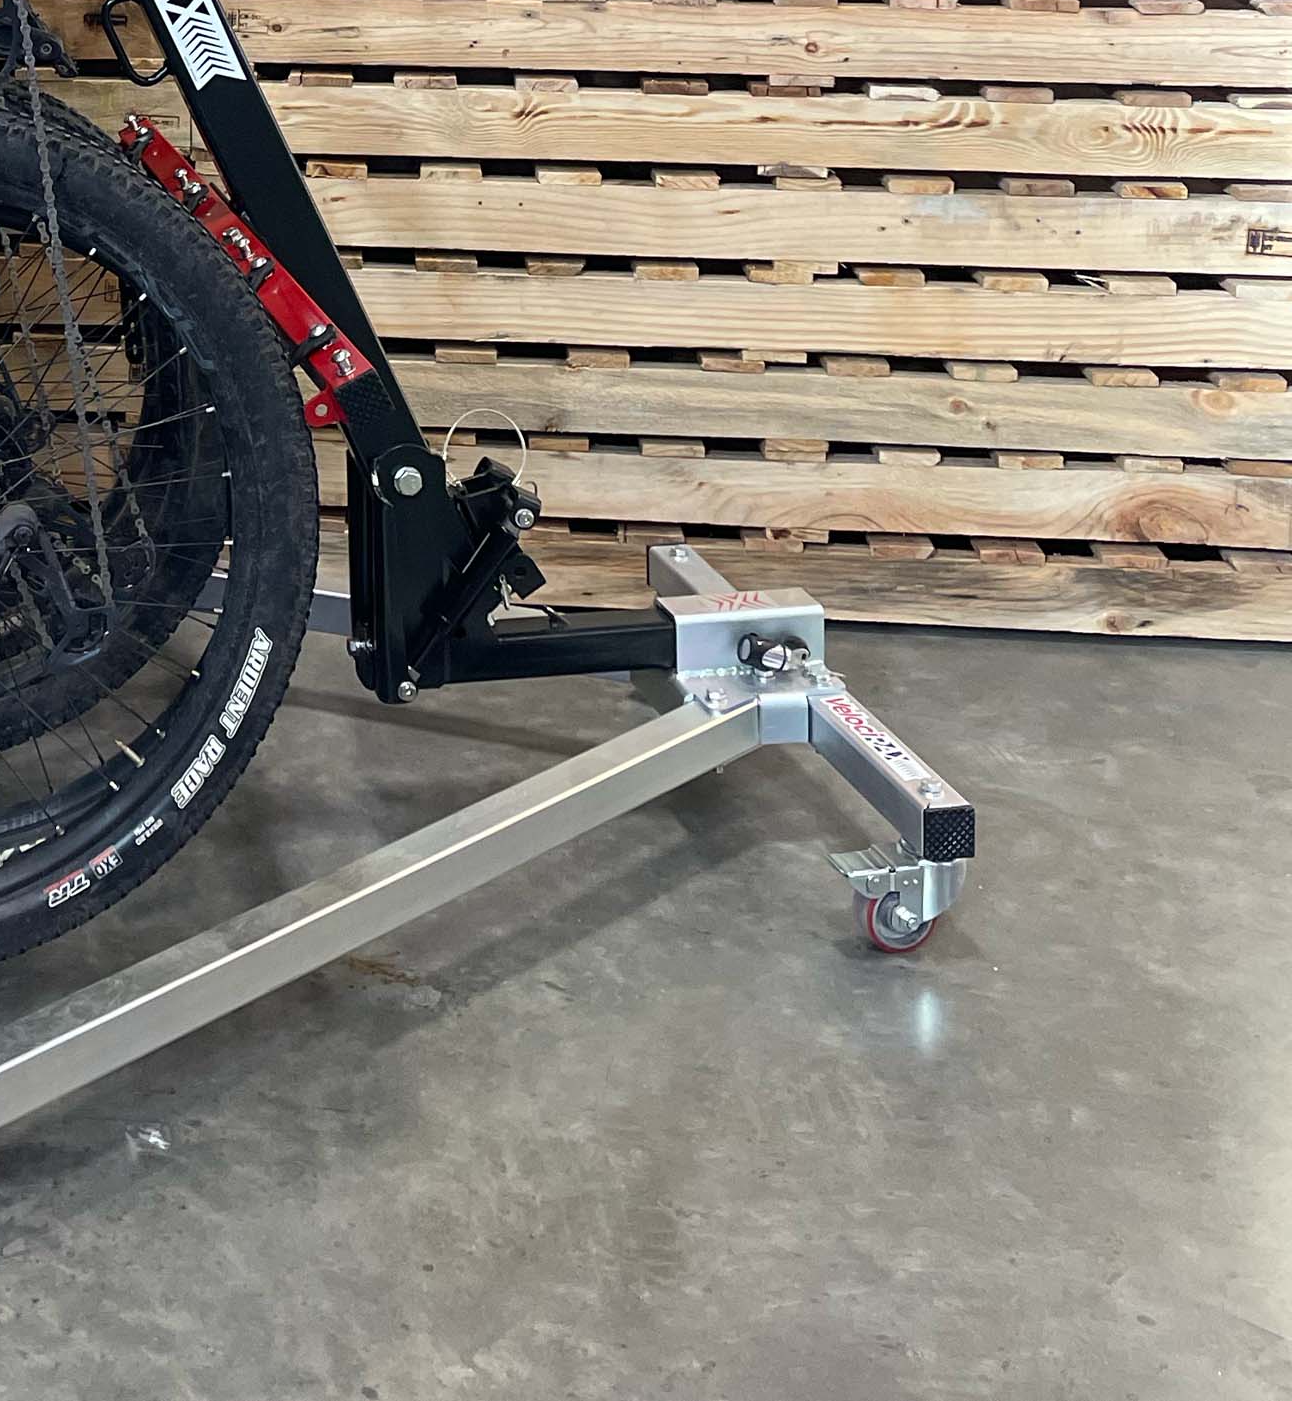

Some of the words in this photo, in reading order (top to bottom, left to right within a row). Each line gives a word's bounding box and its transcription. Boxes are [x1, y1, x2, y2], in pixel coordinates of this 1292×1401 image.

[219, 626, 273, 738] ARDENT
[171, 734, 226, 809] RACE
[48, 872, 90, 908] TR
[94, 849, 121, 878] EXO
